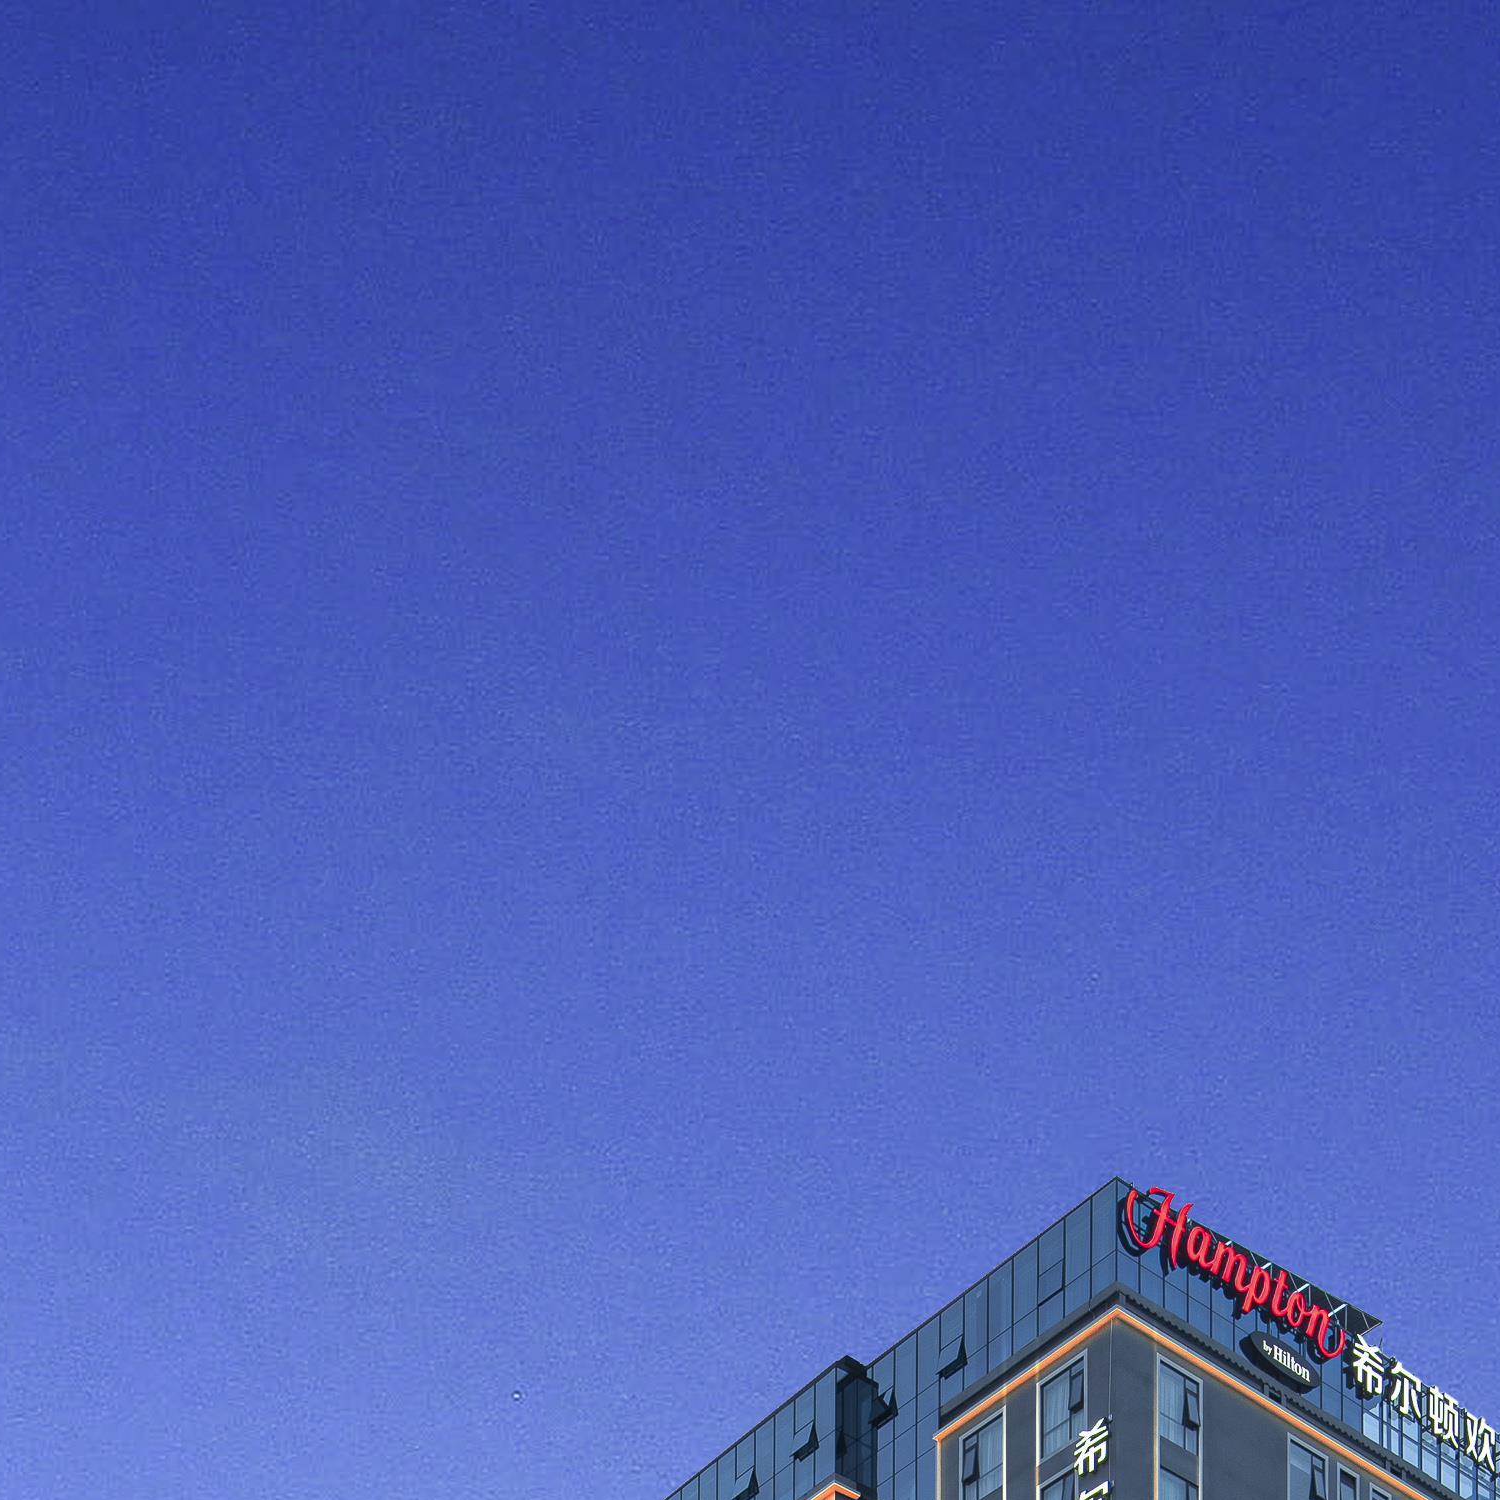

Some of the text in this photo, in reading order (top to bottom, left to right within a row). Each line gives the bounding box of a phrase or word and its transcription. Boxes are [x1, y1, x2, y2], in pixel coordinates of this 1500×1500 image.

[1125, 1186, 1347, 1359] Hampton
[1262, 1340, 1311, 1383] by Hilton
